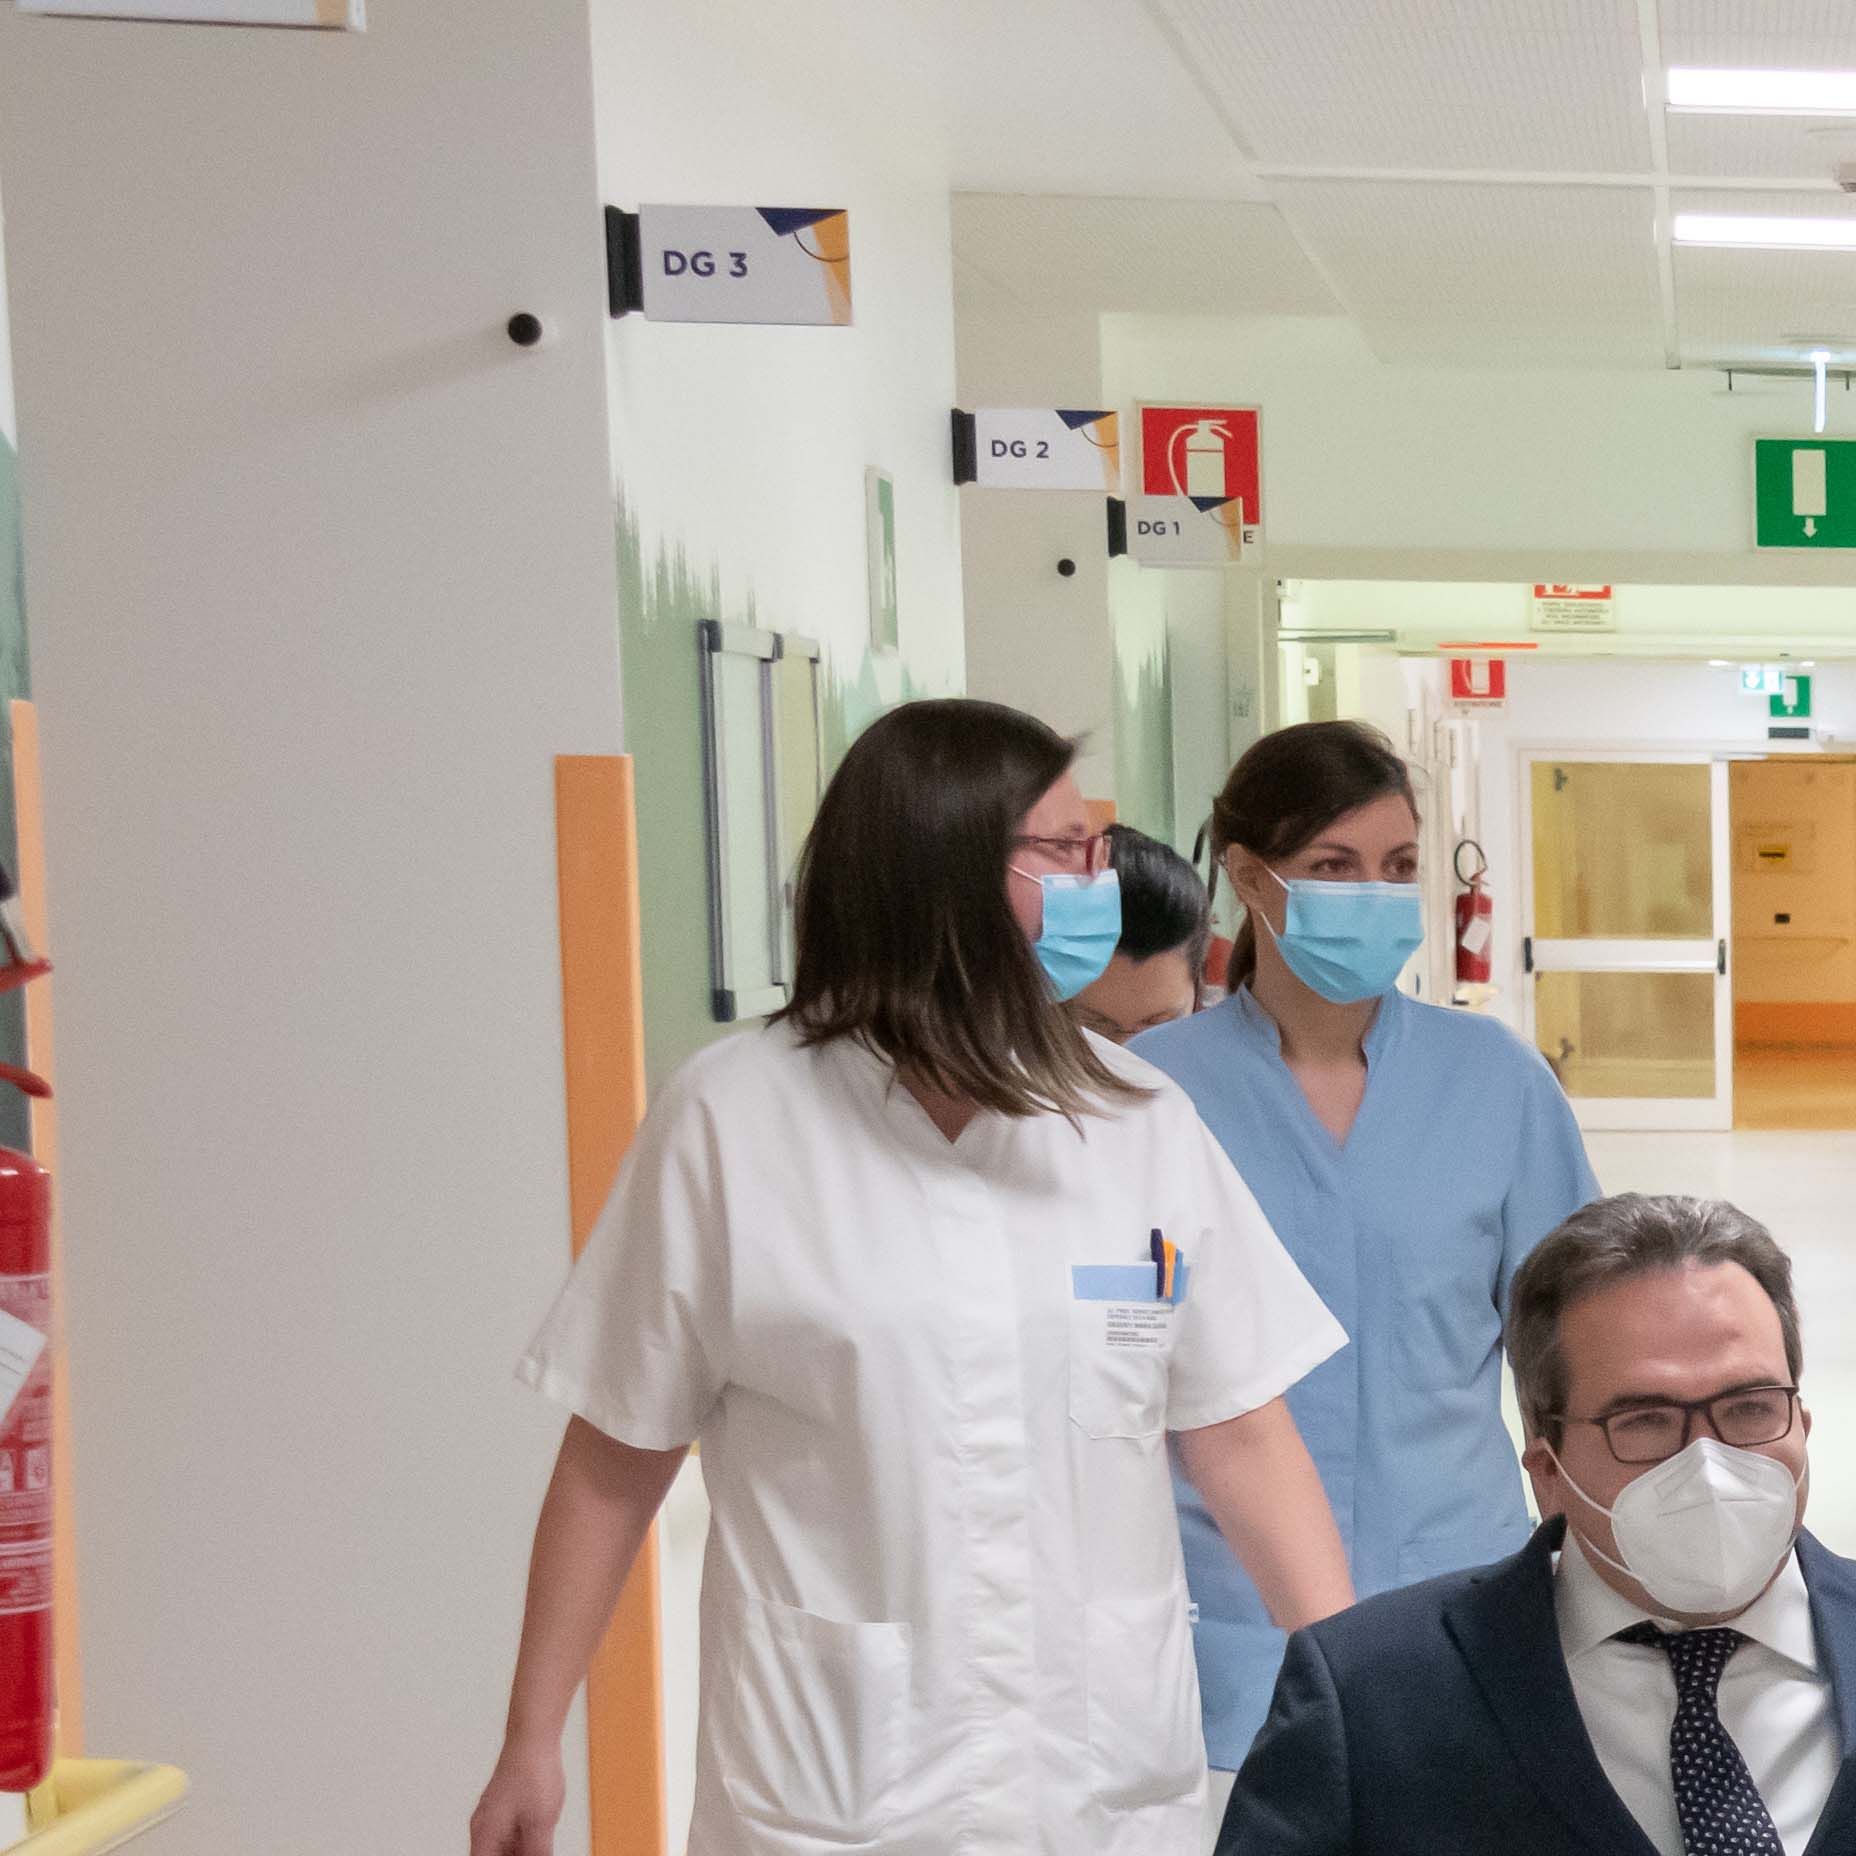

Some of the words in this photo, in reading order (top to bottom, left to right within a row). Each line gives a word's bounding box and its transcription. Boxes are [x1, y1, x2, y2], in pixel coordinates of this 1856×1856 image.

[663, 250, 716, 277] DG
[728, 251, 748, 278] 3
[991, 439, 1027, 458] DG
[1035, 440, 1049, 459] 2
[1137, 520, 1167, 536] DG
[1174, 521, 1180, 536] 1
